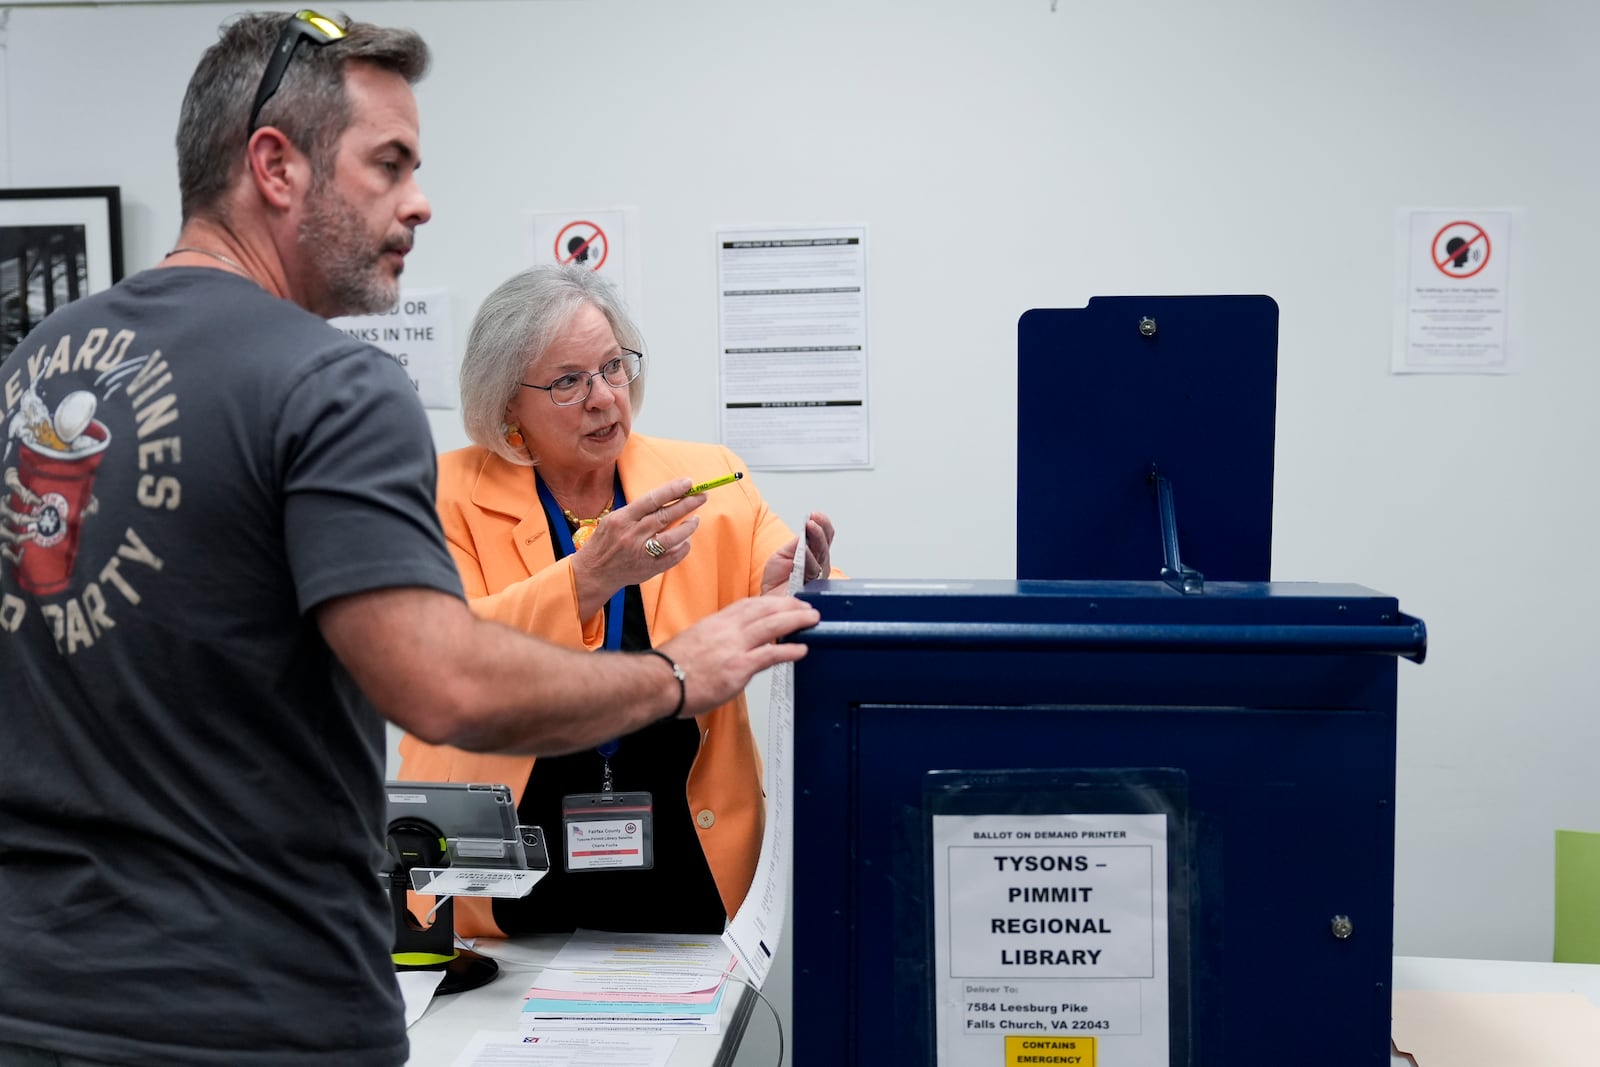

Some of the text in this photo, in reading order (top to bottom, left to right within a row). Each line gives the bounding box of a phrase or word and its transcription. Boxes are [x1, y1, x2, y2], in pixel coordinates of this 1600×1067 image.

[404, 301, 427, 315] OR
[384, 328, 400, 342] IN
[404, 326, 433, 342] THE
[0, 328, 181, 511] EYARD VINES
[41, 527, 164, 654] PARTY
[973, 830, 1127, 840] BALLOT ON DEMAND PRINTER
[994, 855, 1089, 872] TYSONS
[1008, 887, 1093, 903] PIMMIT
[991, 918, 1111, 934] REGIONAL
[1001, 949, 1102, 966] LIBRARY
[966, 985, 1018, 994] Deliver To:
[967, 1002, 1088, 1014] 7584 Leesburg Pike
[966, 1019, 1110, 1031] Falls Church, VA 22043
[1022, 1041, 1076, 1050] CONTAINS
[1017, 1055, 1081, 1064] EMERGENCY
